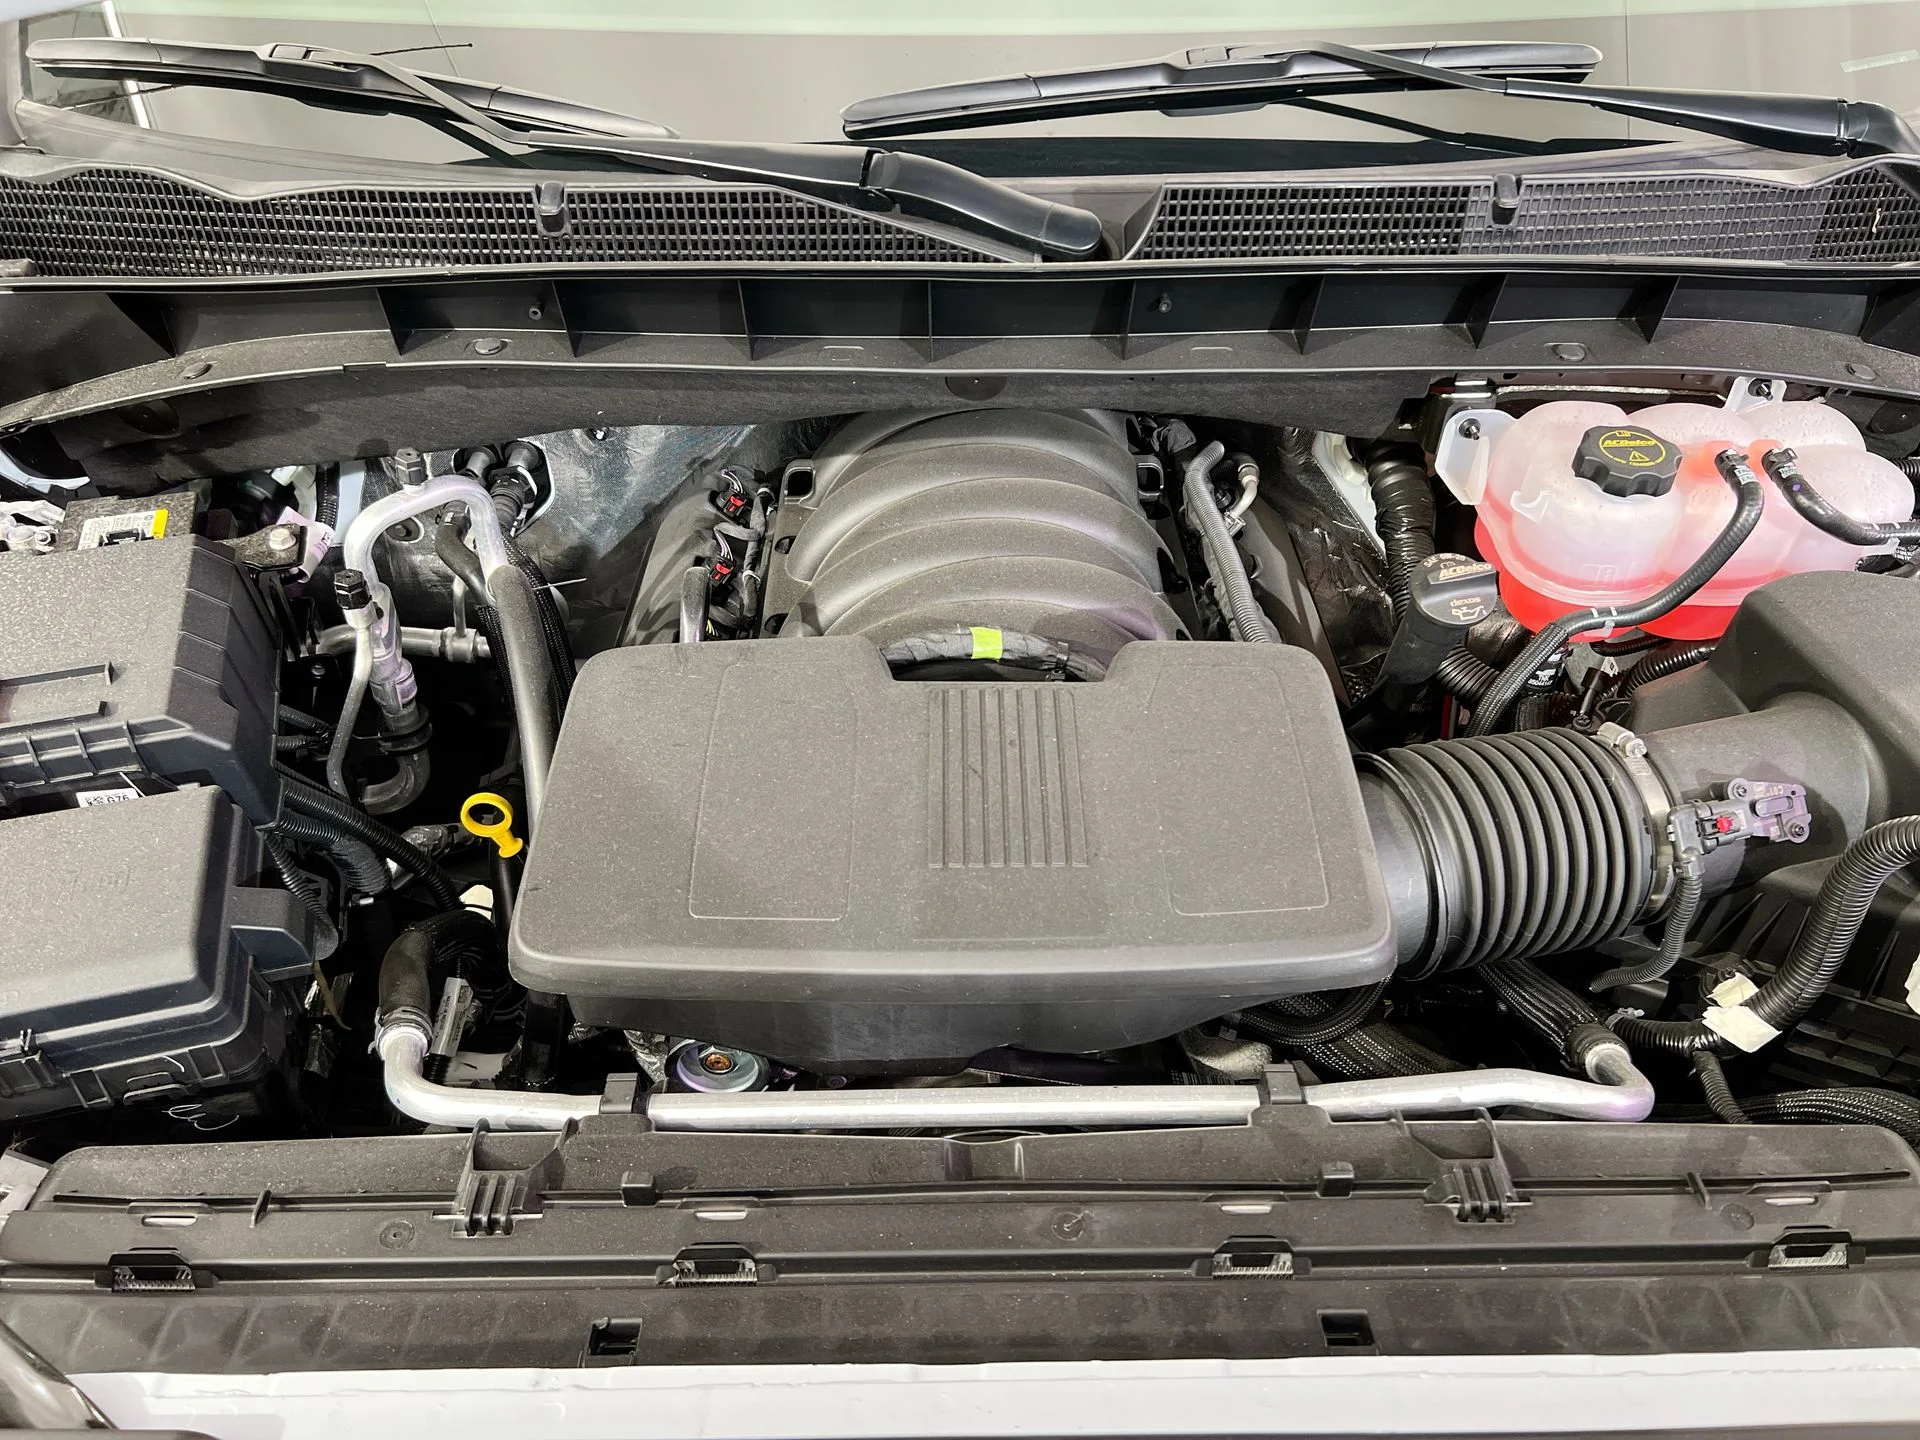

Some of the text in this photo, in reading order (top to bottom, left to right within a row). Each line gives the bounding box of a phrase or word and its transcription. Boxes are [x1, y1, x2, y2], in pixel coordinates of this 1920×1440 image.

[1602, 439, 1656, 448] ACDelco
[1423, 555, 1438, 568] SAE
[1439, 563, 1493, 580] ACDelco
